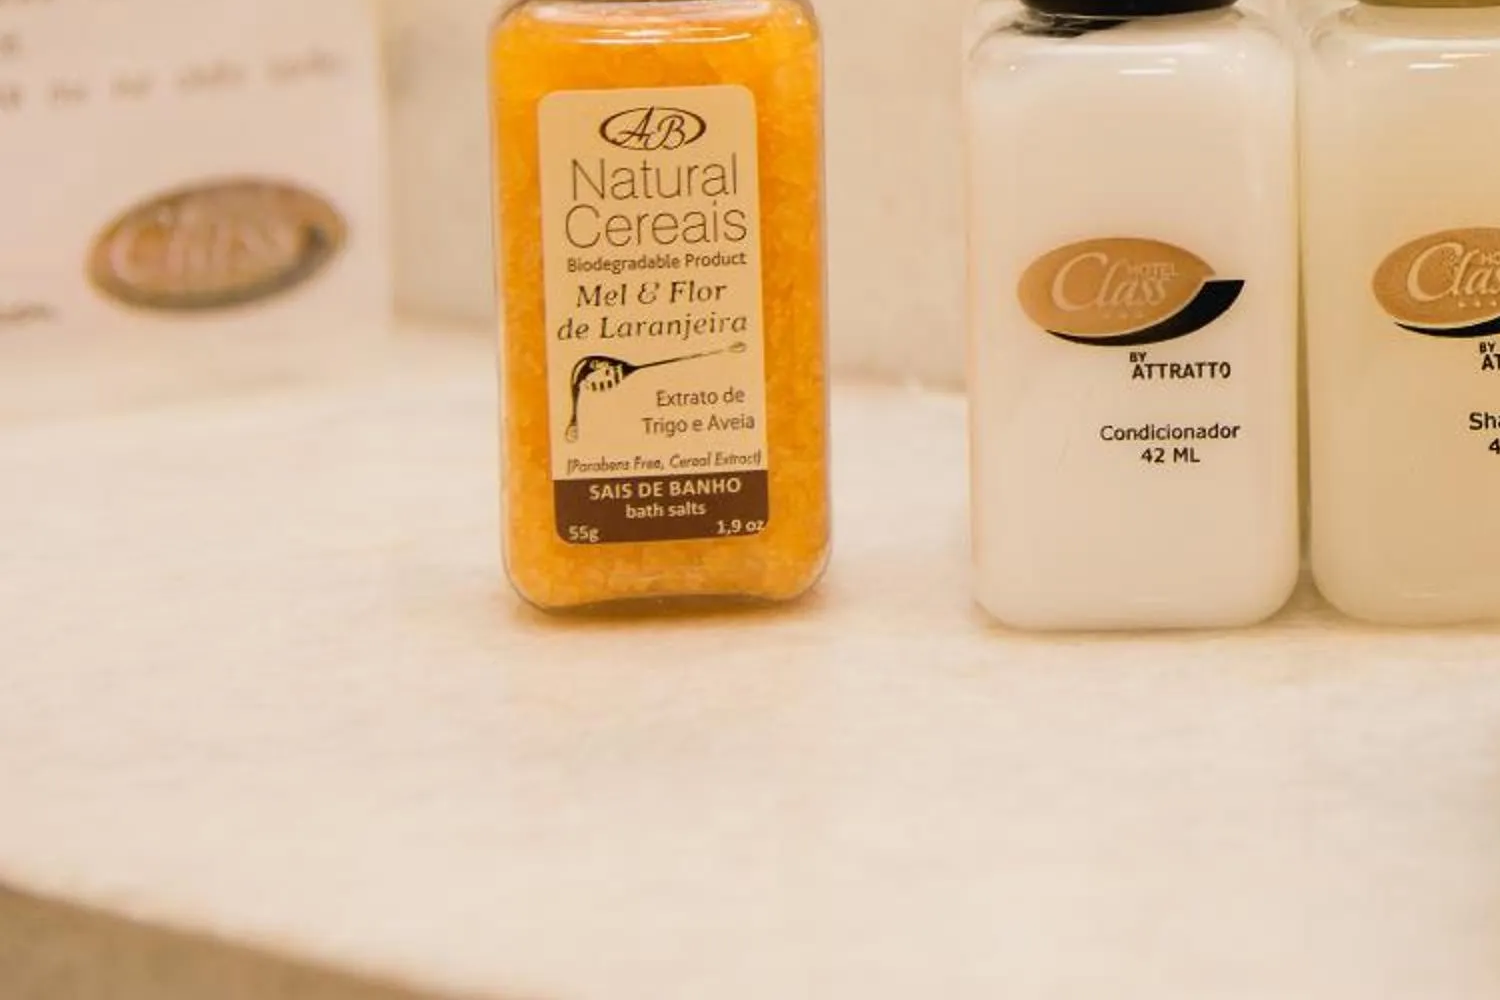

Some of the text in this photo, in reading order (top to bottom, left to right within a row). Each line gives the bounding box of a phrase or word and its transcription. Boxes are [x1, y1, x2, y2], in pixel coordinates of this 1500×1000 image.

[571, 152, 737, 201] Natural
[565, 200, 747, 249] Cereais
[567, 252, 747, 275] Biodegradable Product
[1052, 252, 1167, 312] Class
[576, 281, 728, 308] Mel & Flor
[557, 311, 747, 341] de Laranjeira
[1129, 351, 1147, 363] BY
[1479, 342, 1495, 354] BY
[1132, 361, 1231, 380] ATTRATTO
[656, 387, 746, 407] Extrato de
[642, 414, 755, 438] Trigo e Aveia
[1100, 422, 1241, 442] Condicionador
[669, 453, 711, 469] Cereal
[1141, 447, 1201, 463] 42 ML
[589, 477, 742, 501] SAIS DE BANHO
[625, 501, 707, 519] bath salts
[568, 519, 765, 543] 55g 1,9 oz
